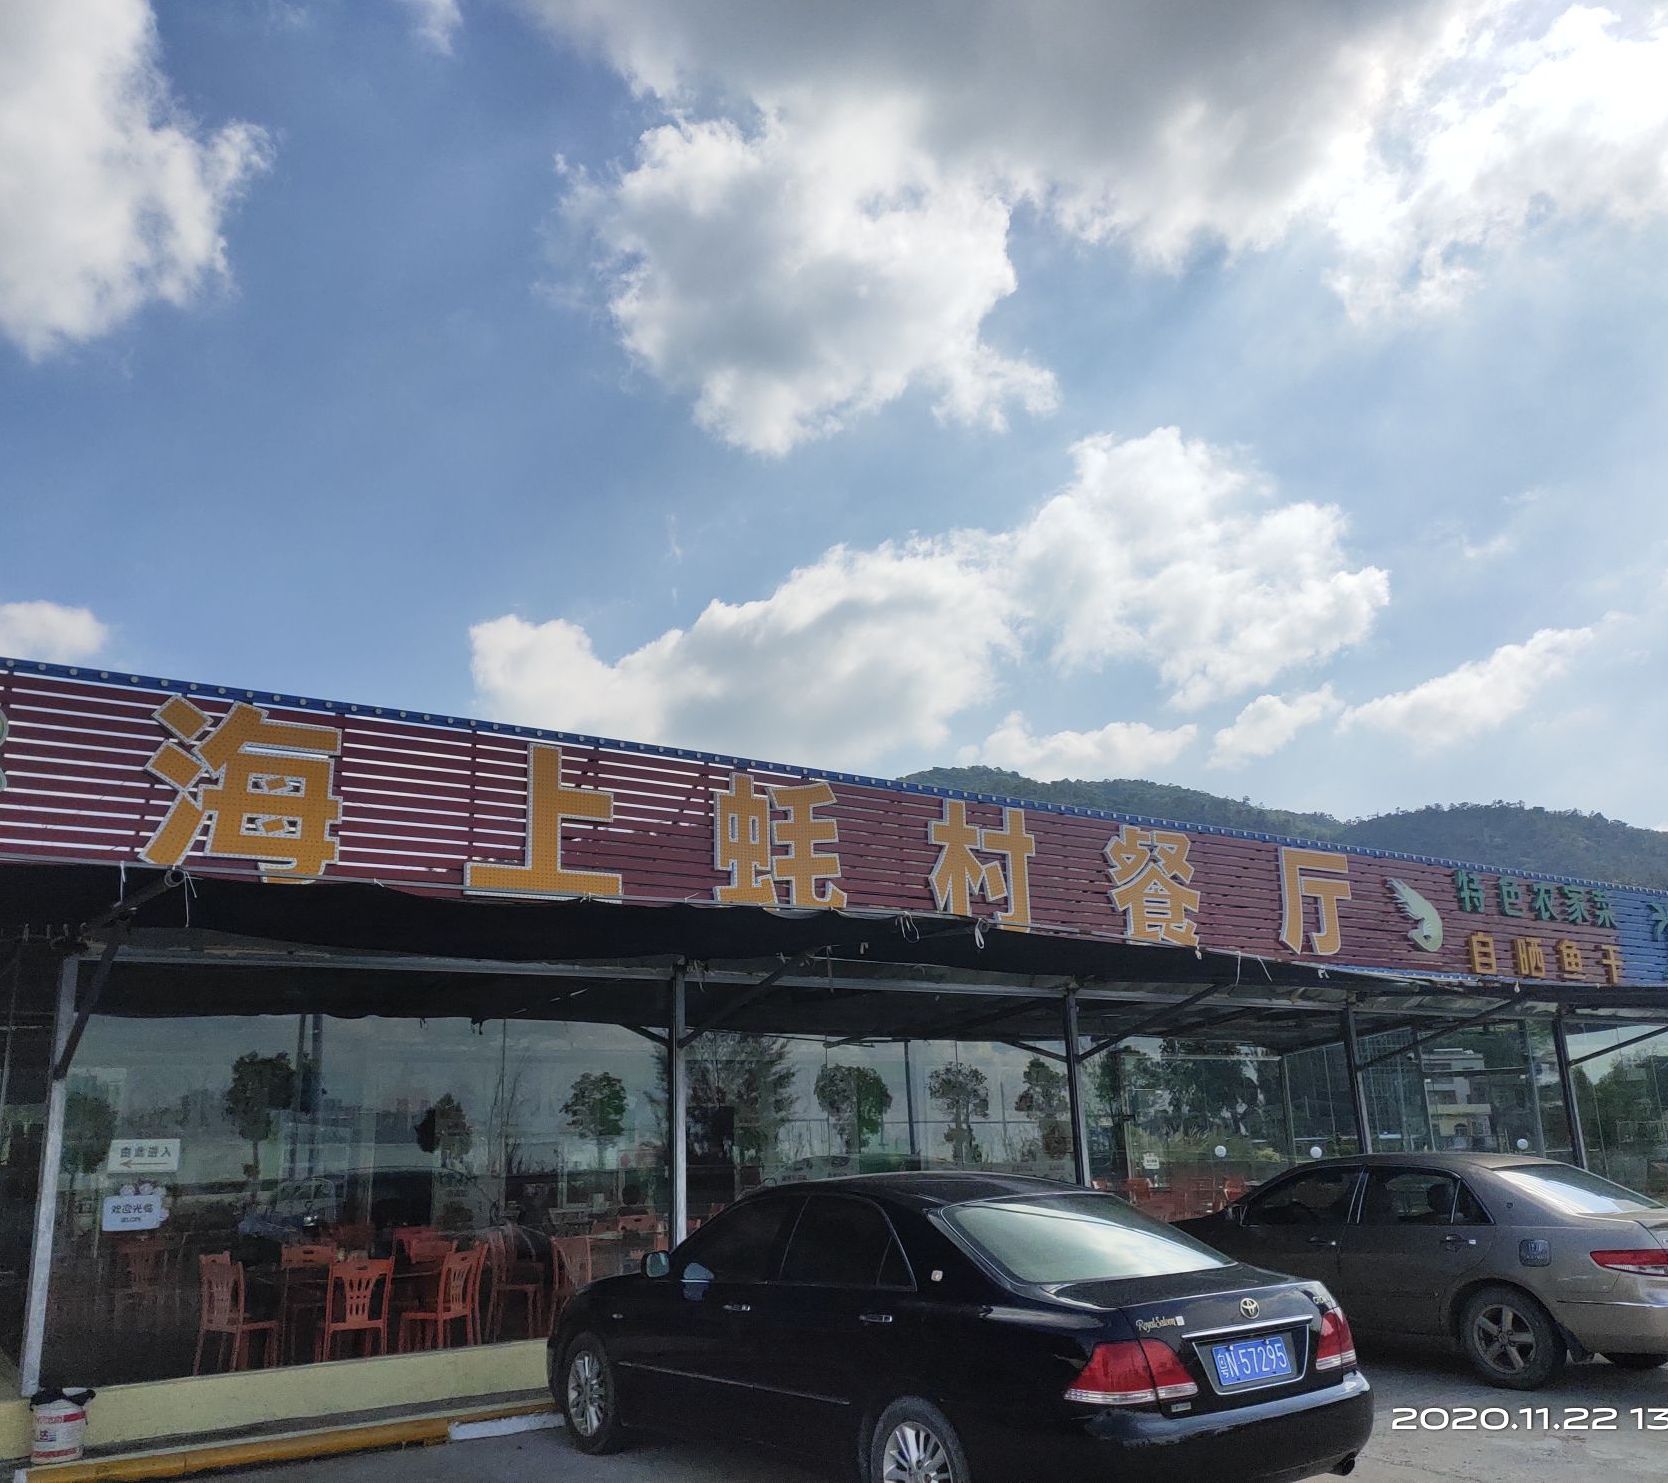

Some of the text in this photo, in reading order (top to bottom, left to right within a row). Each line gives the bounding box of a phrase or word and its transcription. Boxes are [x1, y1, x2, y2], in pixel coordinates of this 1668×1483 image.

[137, 694, 1353, 956] 海上蚝村餐厅
[1453, 868, 1617, 929] 特色农家菜
[1467, 930, 1623, 985] 自晒鱼干
[111, 1203, 154, 1214] 欢迎光临
